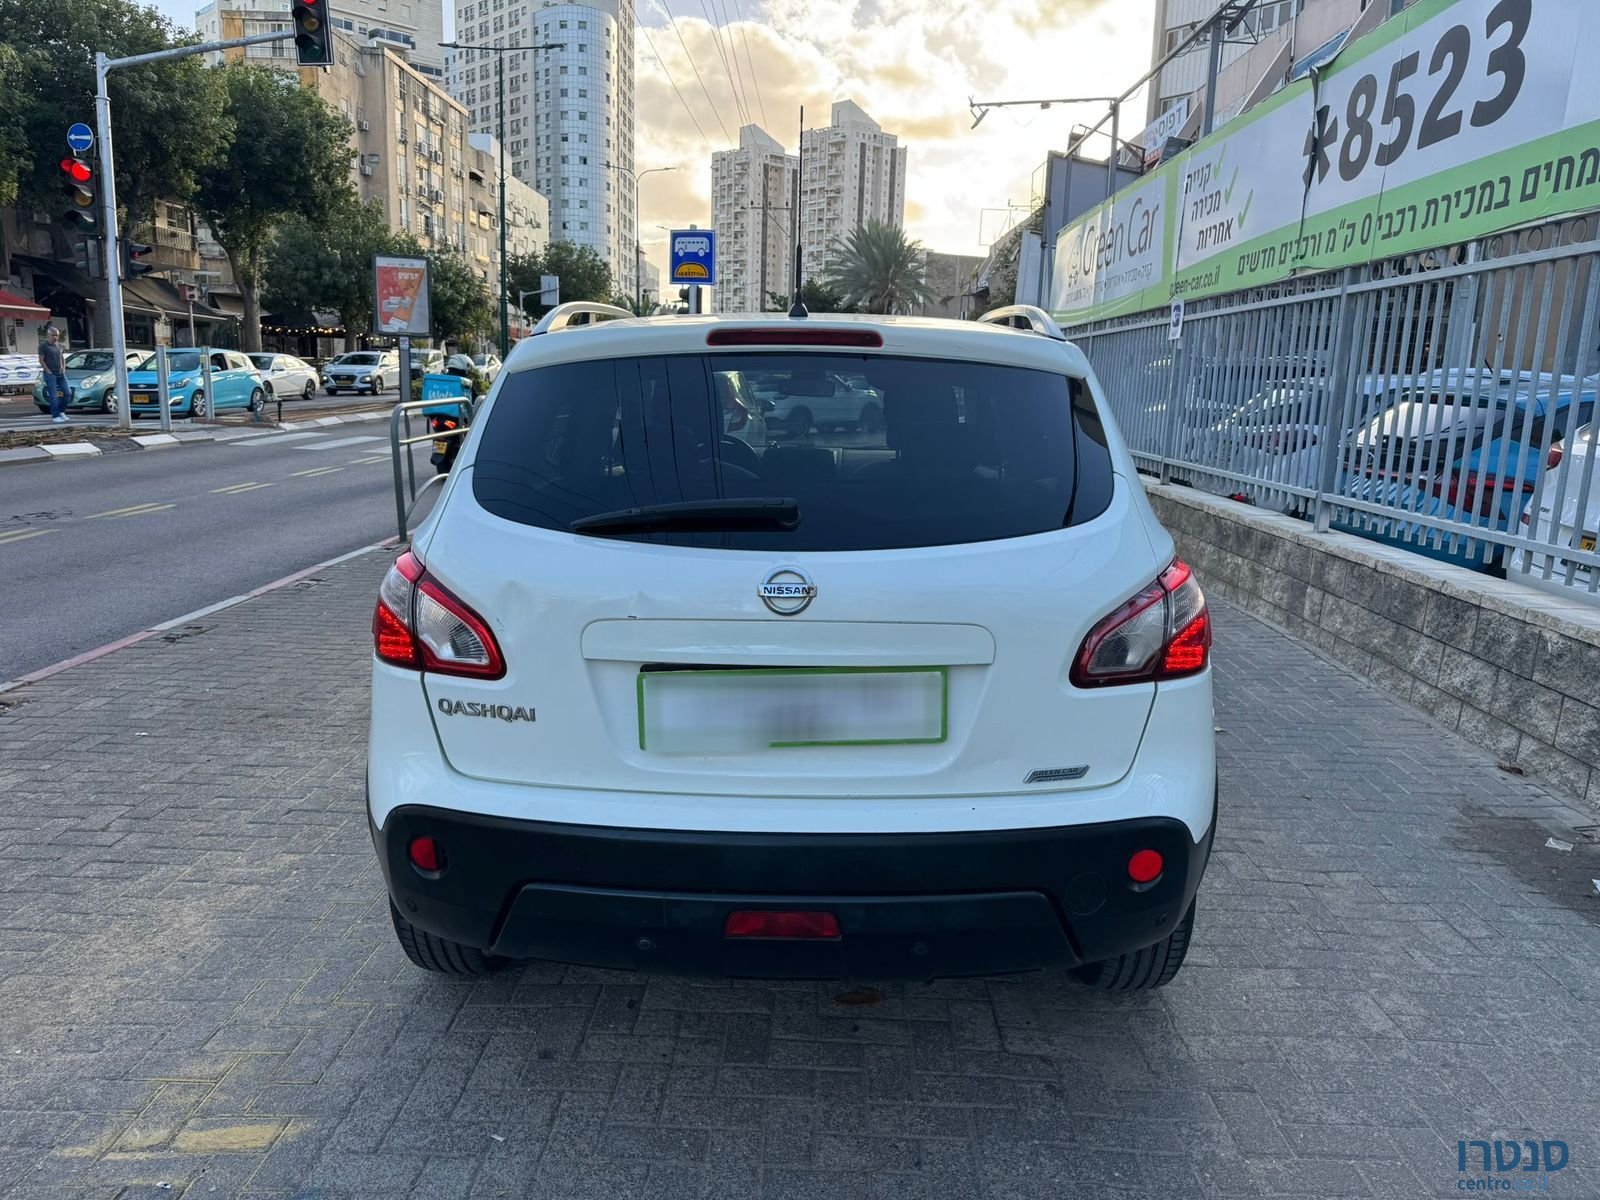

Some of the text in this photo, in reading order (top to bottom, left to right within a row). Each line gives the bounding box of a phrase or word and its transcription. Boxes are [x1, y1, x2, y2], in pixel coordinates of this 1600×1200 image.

[1159, 106, 1182, 137] דפוס
[1185, 163, 1211, 194] קנייה
[1519, 147, 1600, 203] מחים
[1191, 189, 1221, 222] מכירה
[1421, 175, 1511, 230] במכירת
[1083, 197, 1160, 276] Green Car
[1196, 217, 1234, 251] אחריות
[1360, 212, 1372, 246] 0
[1376, 204, 1417, 241] רכבי
[1237, 246, 1276, 276] חדשים
[1278, 231, 1322, 265] ורכבים
[763, 586, 811, 595] NISSAN
[437, 698, 537, 723] QASHQAI
[1032, 769, 1060, 777] GREEN
